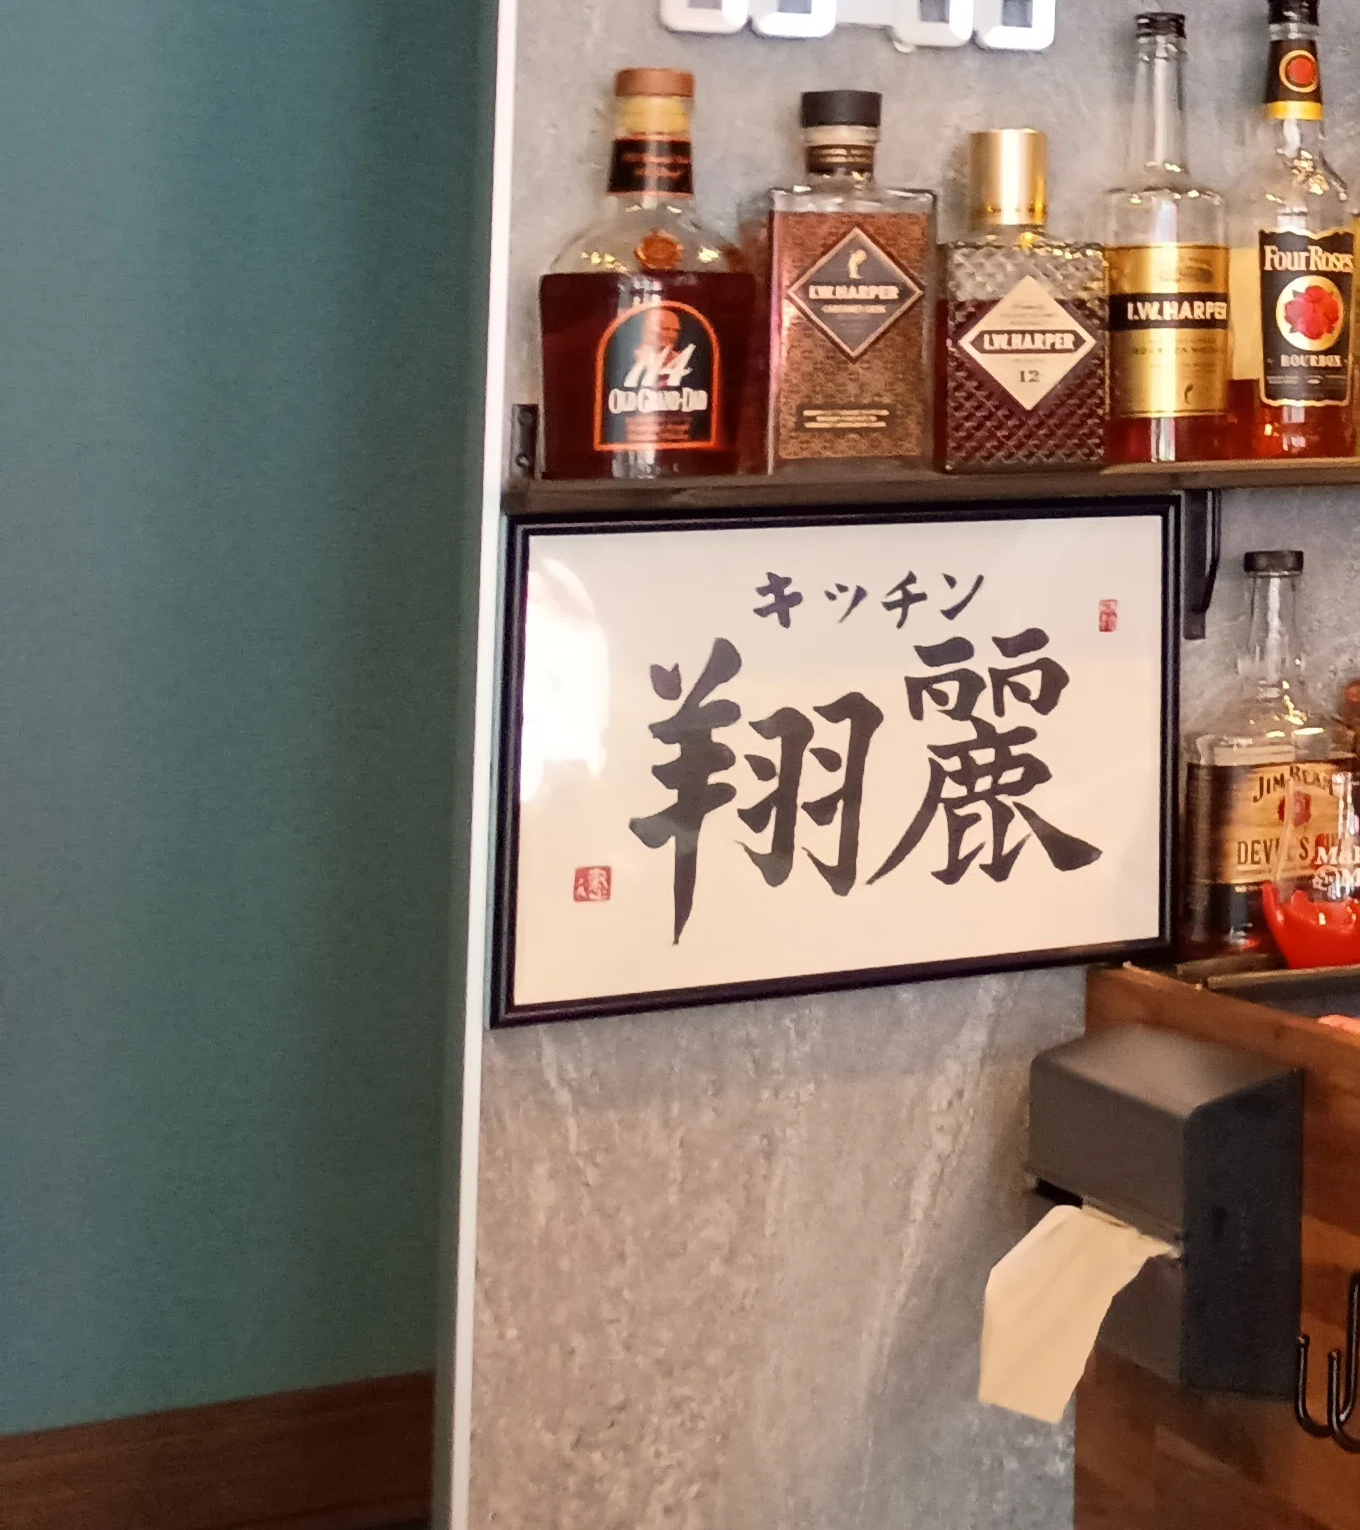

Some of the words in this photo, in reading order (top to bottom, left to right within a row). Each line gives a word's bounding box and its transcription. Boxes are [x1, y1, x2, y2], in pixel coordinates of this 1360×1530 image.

[1263, 245, 1309, 272] Four
[1018, 369, 1041, 383] 12
[752, 570, 985, 630] キッチン
[629, 627, 1103, 946] 翔麗
